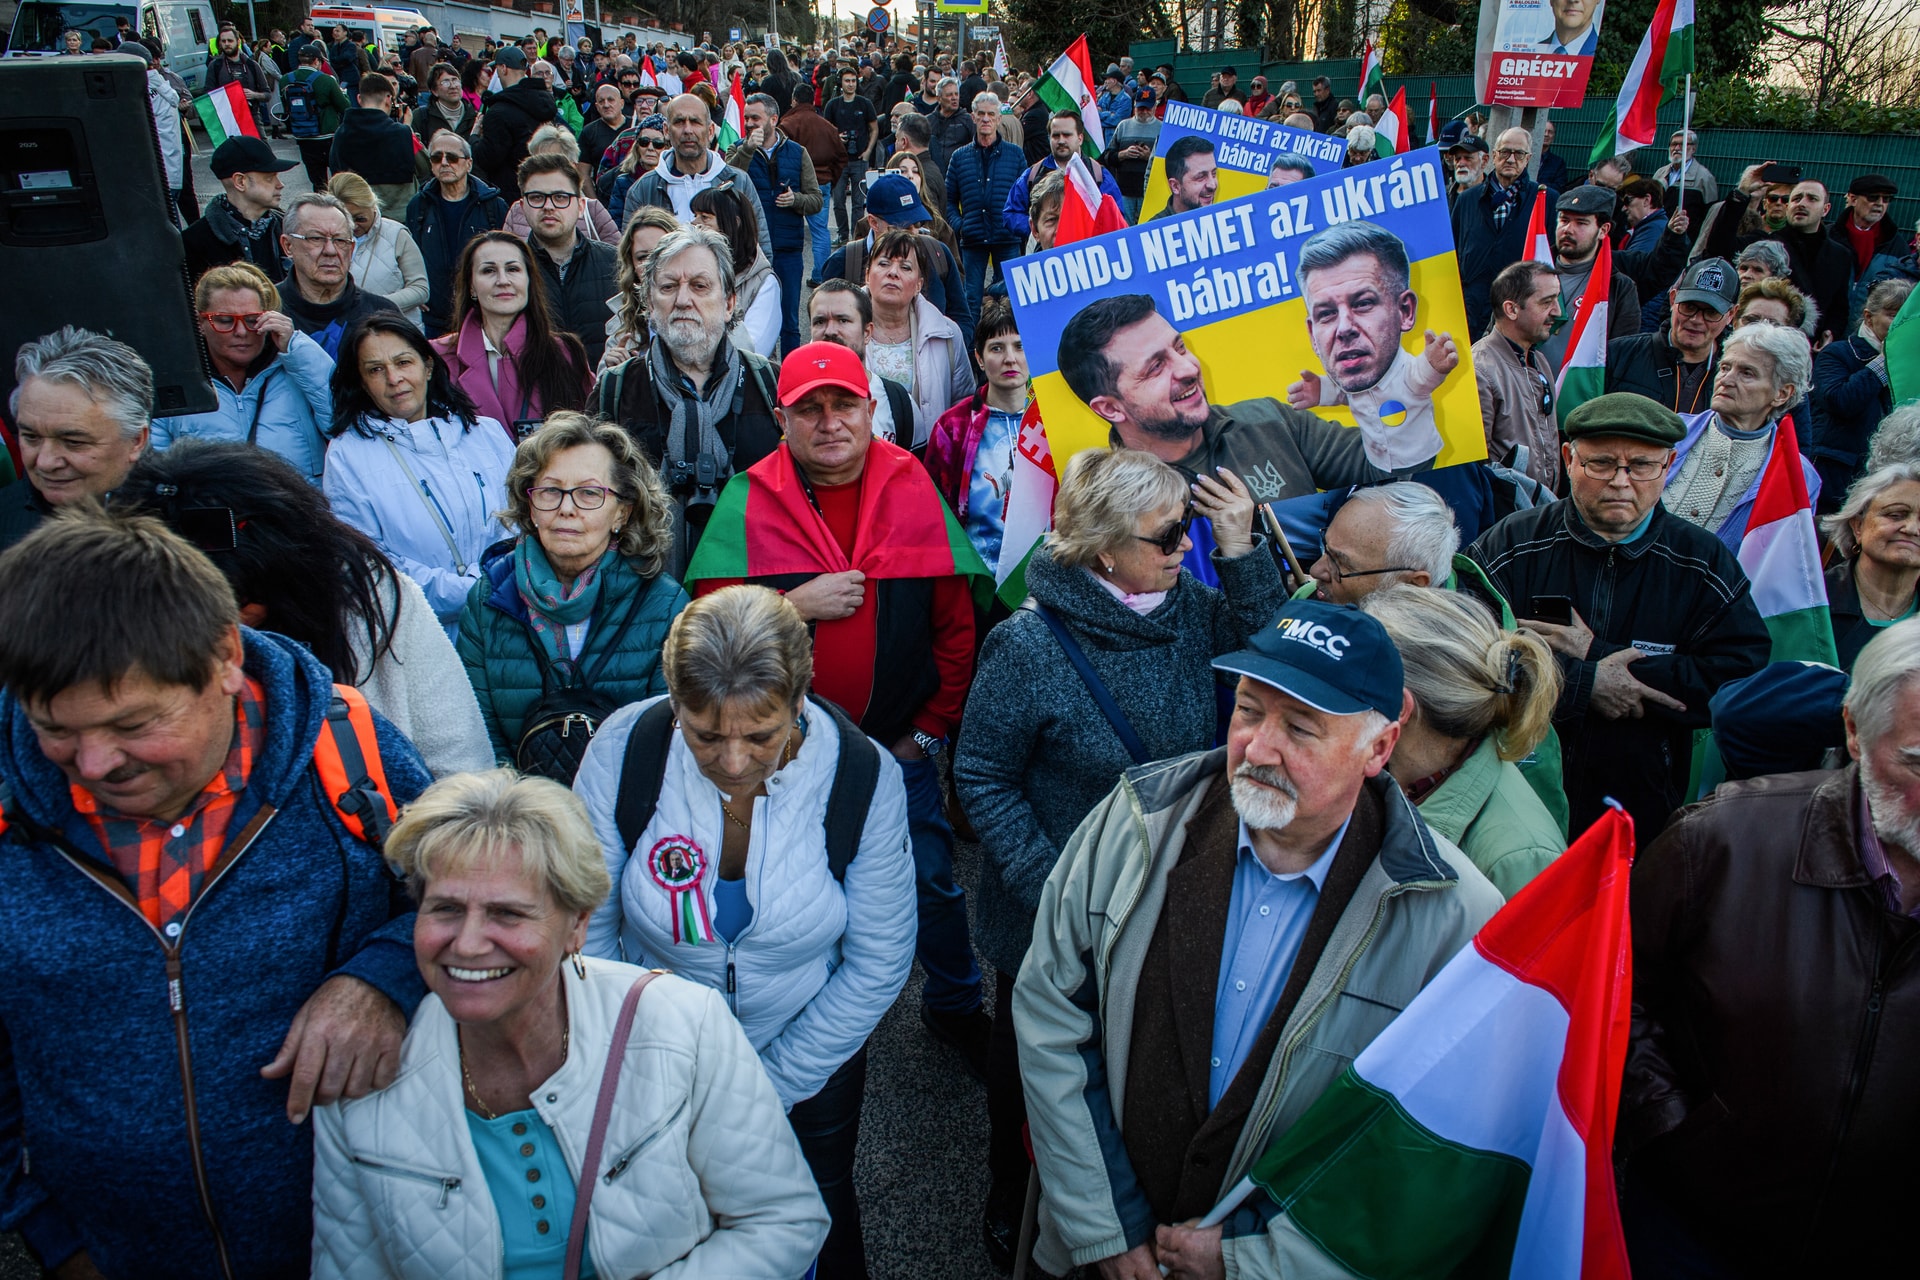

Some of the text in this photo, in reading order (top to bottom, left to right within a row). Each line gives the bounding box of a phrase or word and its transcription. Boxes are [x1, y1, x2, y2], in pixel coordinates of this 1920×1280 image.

[1497, 77, 1525, 86] ZSOLT
[1500, 55, 1578, 78] GRÉCZY
[1165, 104, 1342, 163] MONDJ NEMET az ukrán
[1218, 142, 1271, 173] bábra!
[1011, 158, 1439, 307] MONDJ NEMET az ukrán
[1167, 251, 1293, 321] bábra!
[1284, 619, 1351, 657] MCC
